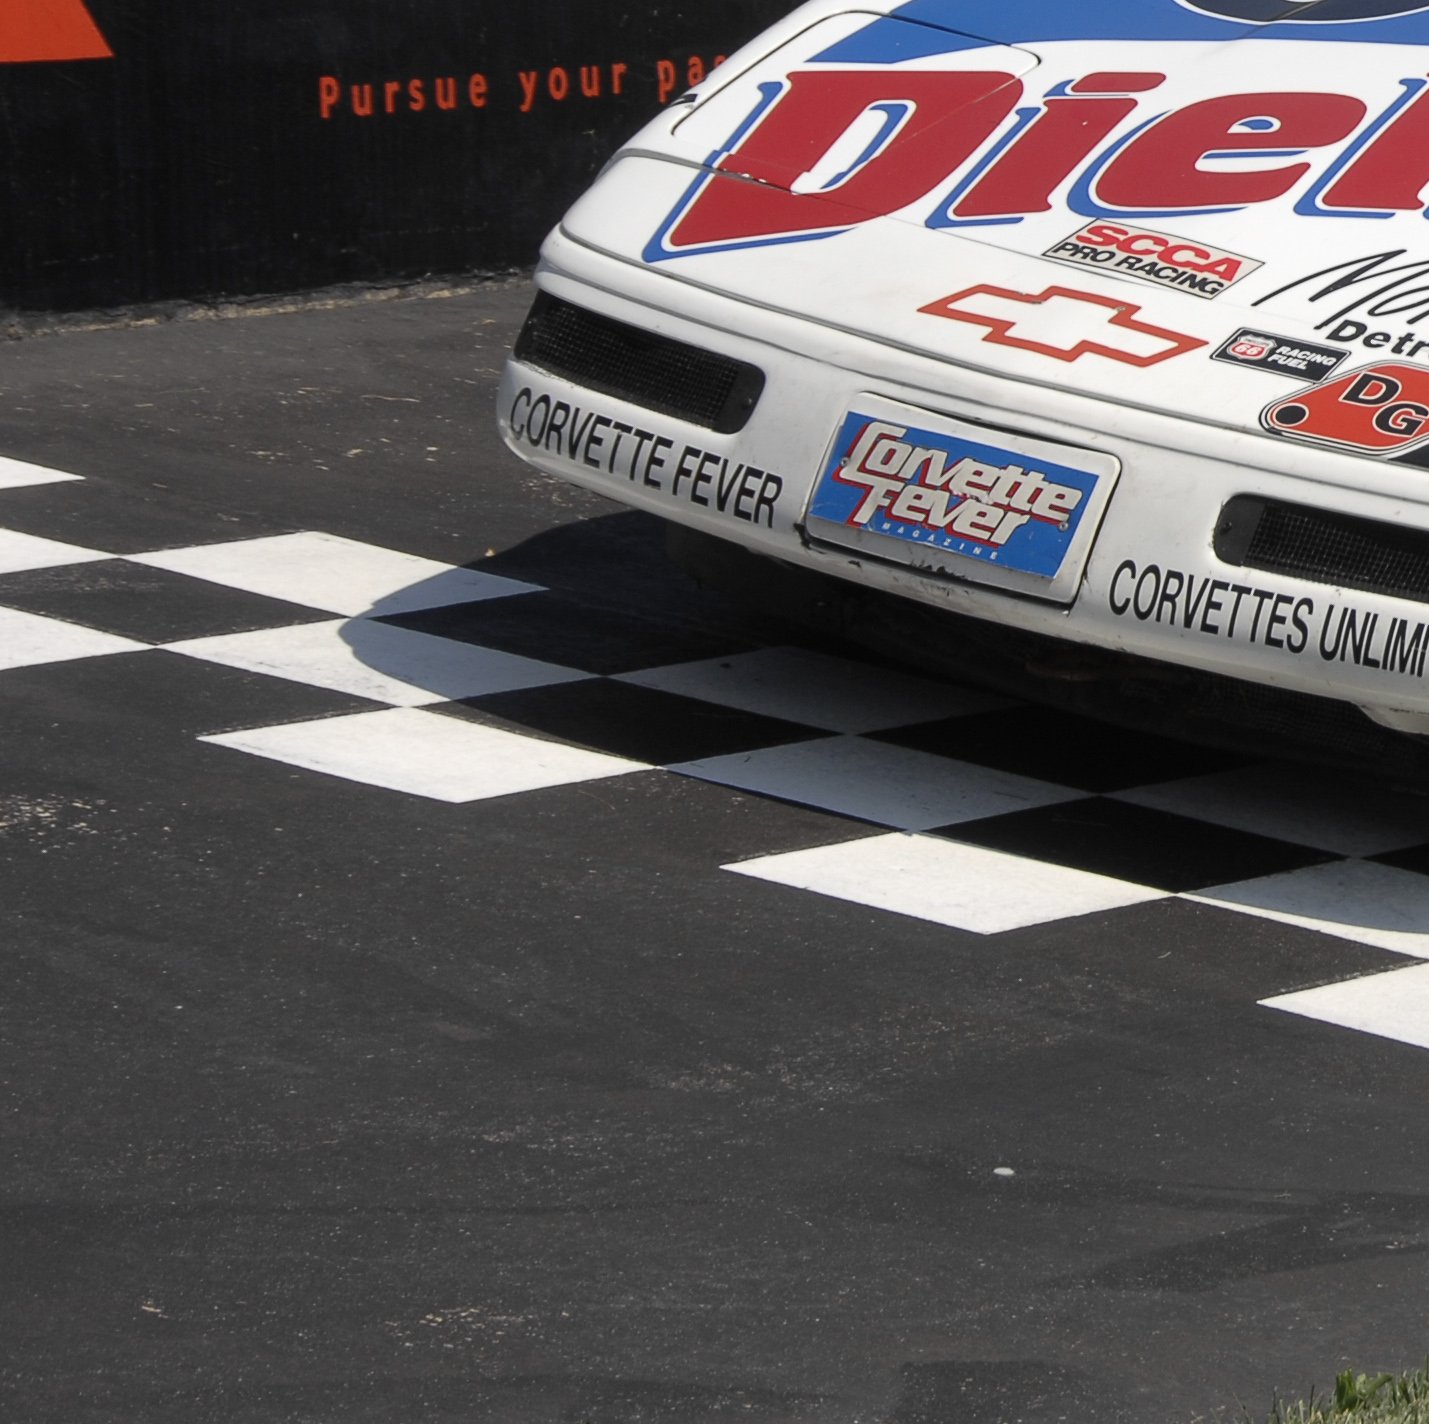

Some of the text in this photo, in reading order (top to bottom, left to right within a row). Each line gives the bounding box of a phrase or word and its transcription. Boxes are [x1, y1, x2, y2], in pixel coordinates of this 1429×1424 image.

[320, 73, 488, 119] Pursue
[519, 61, 626, 112] your
[1052, 241, 1225, 296] PRO RACING
[1075, 225, 1243, 282] SCCA
[1232, 342, 1265, 357] 66
[1267, 353, 1308, 370] FUEL
[1275, 345, 1337, 367] RACING
[508, 387, 783, 529] CORVETTE FEVER
[833, 420, 1083, 521] Corvette
[847, 478, 1031, 548] Fever
[881, 522, 999, 560] MAGAZINE
[1108, 559, 1313, 654] CORVETTES
